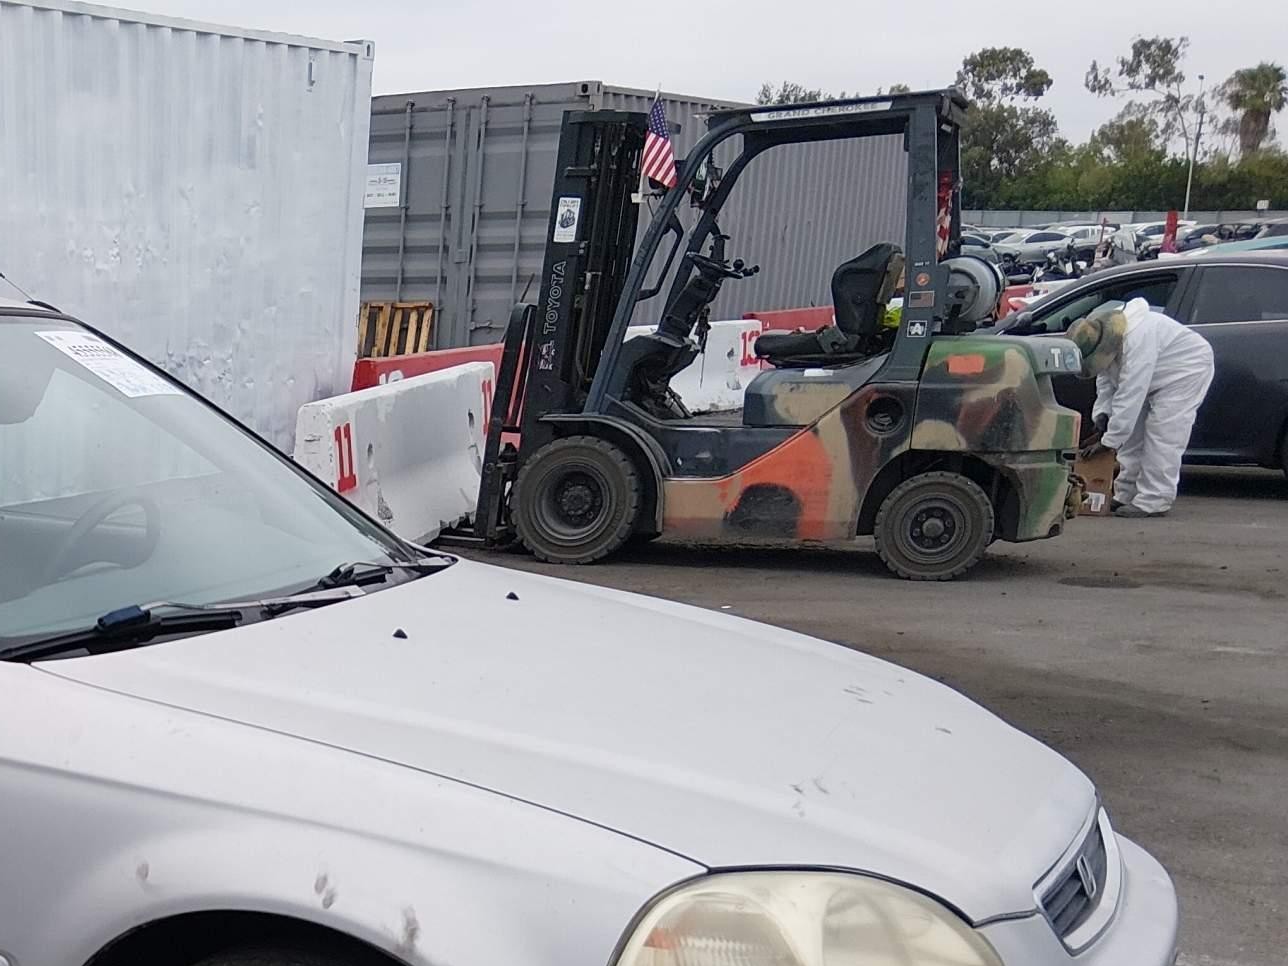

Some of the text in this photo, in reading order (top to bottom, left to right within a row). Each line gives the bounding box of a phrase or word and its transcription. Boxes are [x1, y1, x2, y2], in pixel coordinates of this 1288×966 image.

[767, 102, 879, 120] GRAND CHEROKEE
[543, 261, 566, 334] TOYOTA
[334, 422, 357, 493] 11
